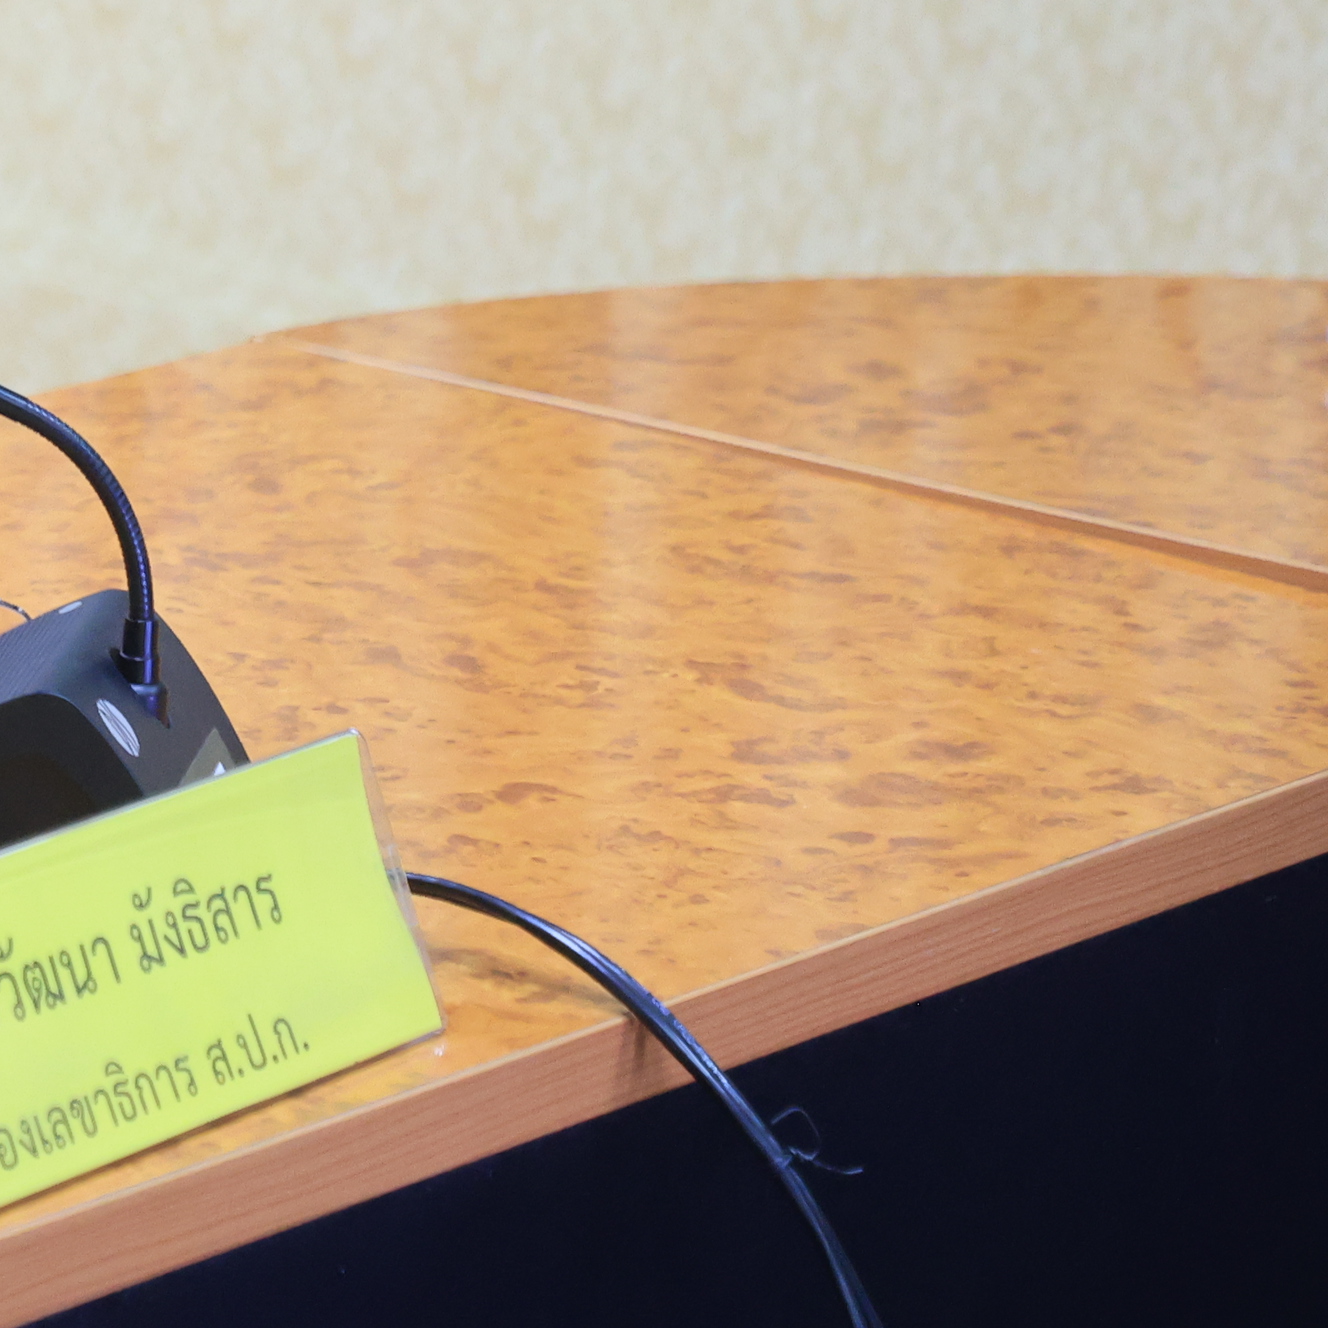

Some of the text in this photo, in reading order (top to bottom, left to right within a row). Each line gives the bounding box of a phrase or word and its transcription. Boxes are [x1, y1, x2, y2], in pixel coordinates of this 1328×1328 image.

[129, 873, 283, 974] มังธิสาร
[206, 1013, 310, 1086] ส.ป.ก.
